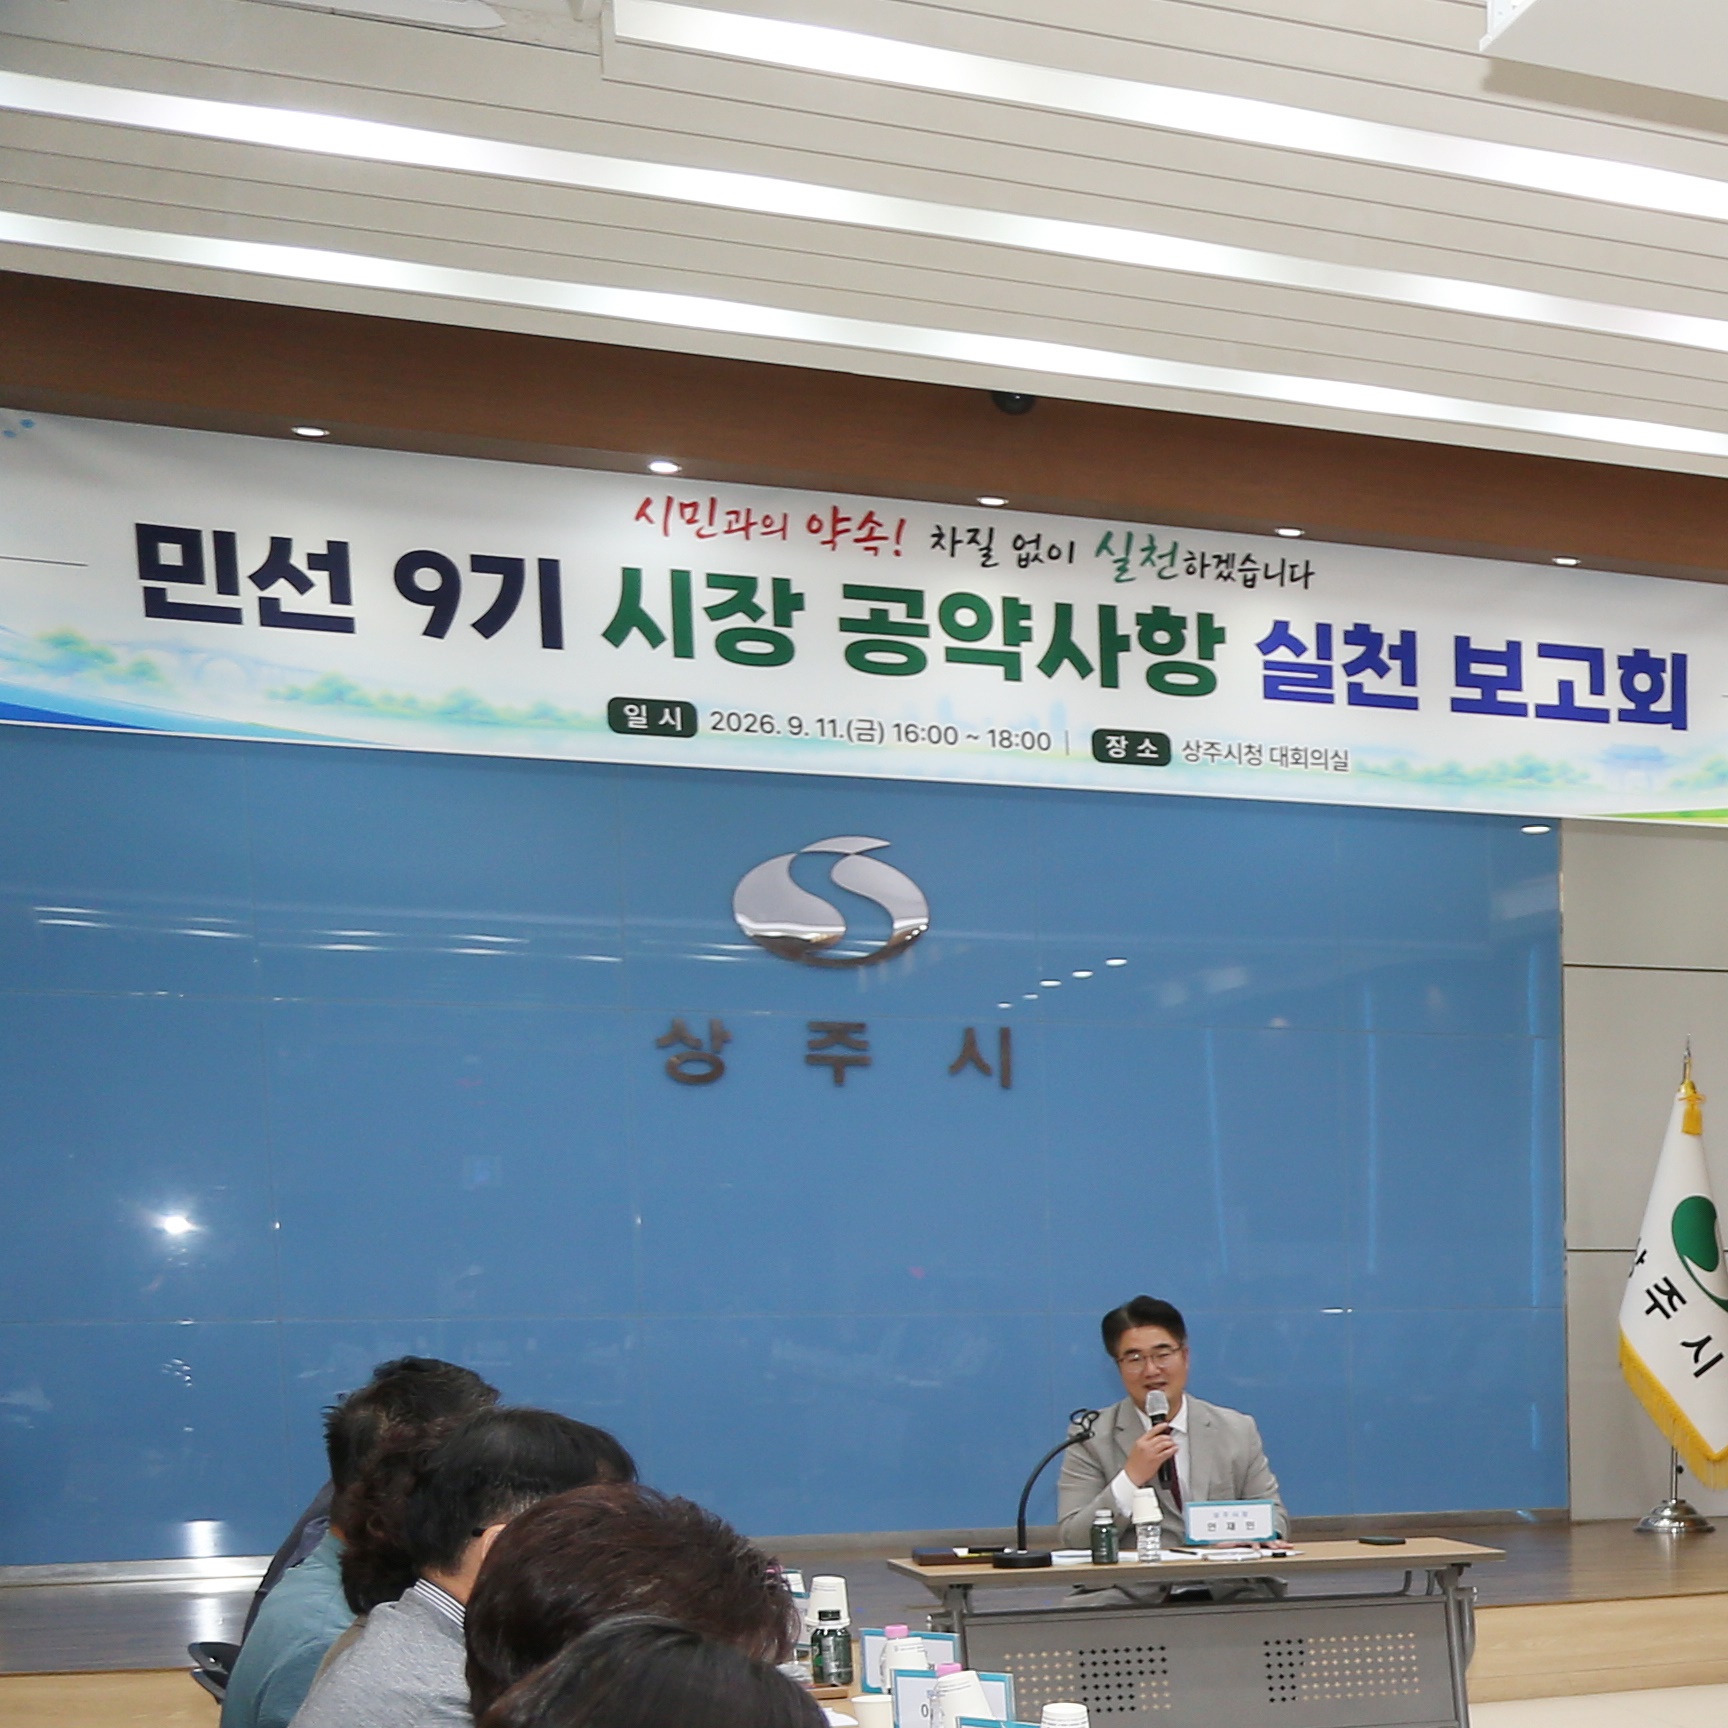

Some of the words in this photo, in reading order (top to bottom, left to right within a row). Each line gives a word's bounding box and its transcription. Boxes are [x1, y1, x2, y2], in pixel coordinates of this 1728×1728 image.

[634, 496, 789, 541] 시민과의
[806, 505, 907, 556] 약속!
[930, 525, 1000, 568] 차질
[1012, 533, 1076, 569] 없이
[1095, 530, 1315, 590] 실천하겠습니다
[135, 522, 356, 634] 민선
[393, 549, 565, 650] 9기
[601, 566, 804, 668] 시장
[839, 583, 1226, 697] 공약사항
[1255, 619, 1419, 711] 실천
[1450, 635, 1688, 731] 보고회
[709, 710, 781, 736] 2026.
[788, 715, 808, 737] 9.
[816, 717, 885, 746] 11.(금)
[893, 721, 959, 747] 16:00
[987, 728, 1052, 753] 18:00
[1181, 739, 1265, 767] 상주시청
[1269, 745, 1350, 772] 대회의실
